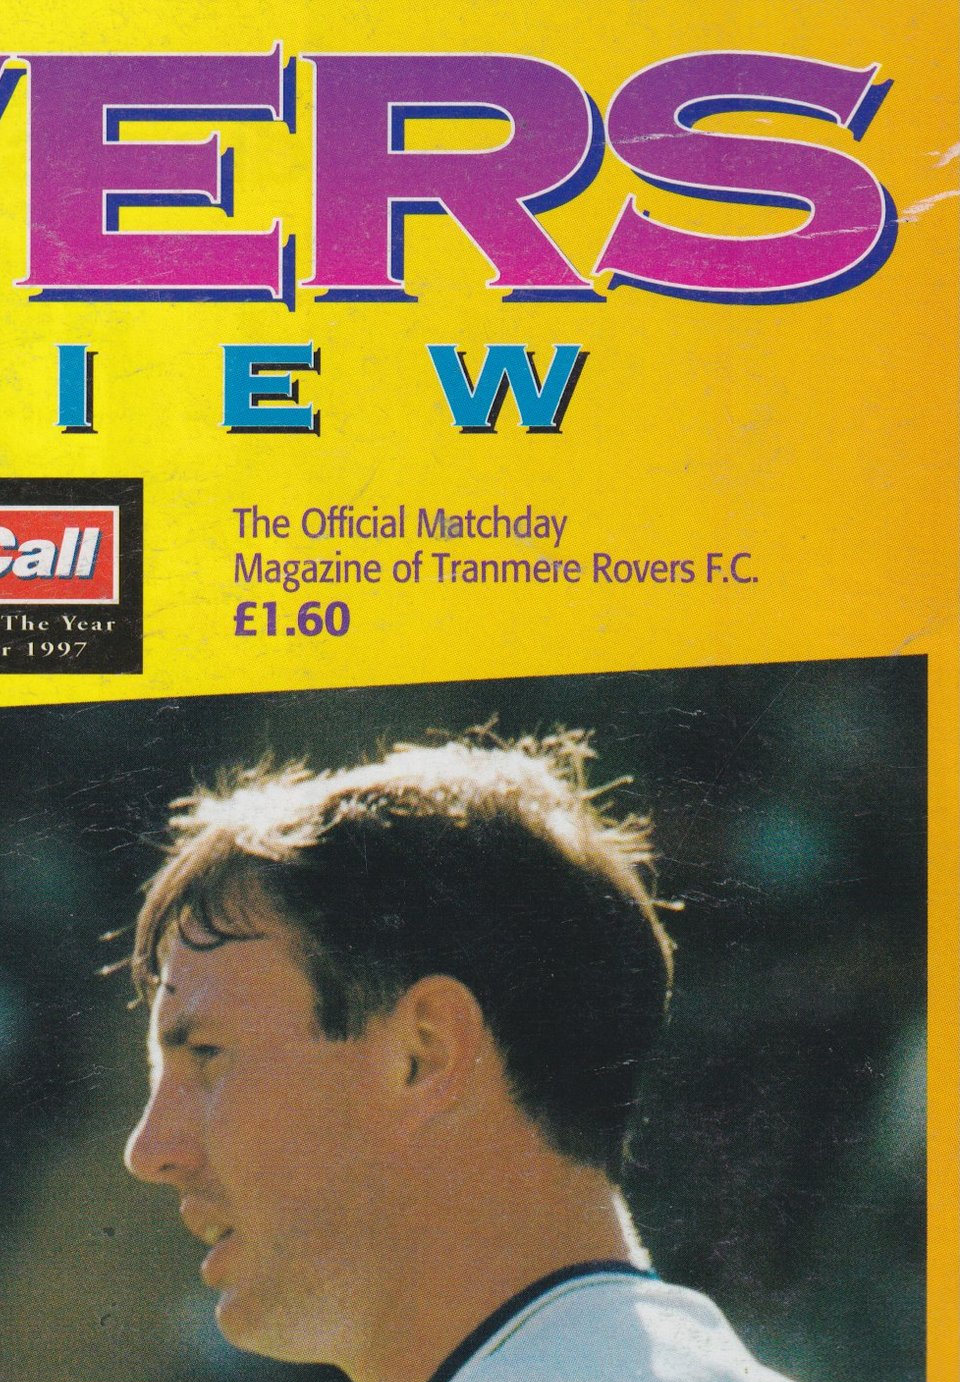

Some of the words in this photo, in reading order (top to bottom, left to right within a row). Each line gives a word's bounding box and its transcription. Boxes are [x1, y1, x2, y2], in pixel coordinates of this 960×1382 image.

[233, 505, 290, 538] The
[301, 505, 405, 539] Official
[417, 505, 567, 548] Matchday
[234, 550, 381, 593] Magazine
[392, 550, 423, 583] of
[432, 552, 582, 583] Tranmere
[593, 552, 695, 583] Rovers
[707, 552, 758, 583] F.C.
[1, 614, 49, 632] The
[62, 614, 116, 632] Year
[234, 601, 350, 636] £1.60
[27, 641, 88, 658] 1997
